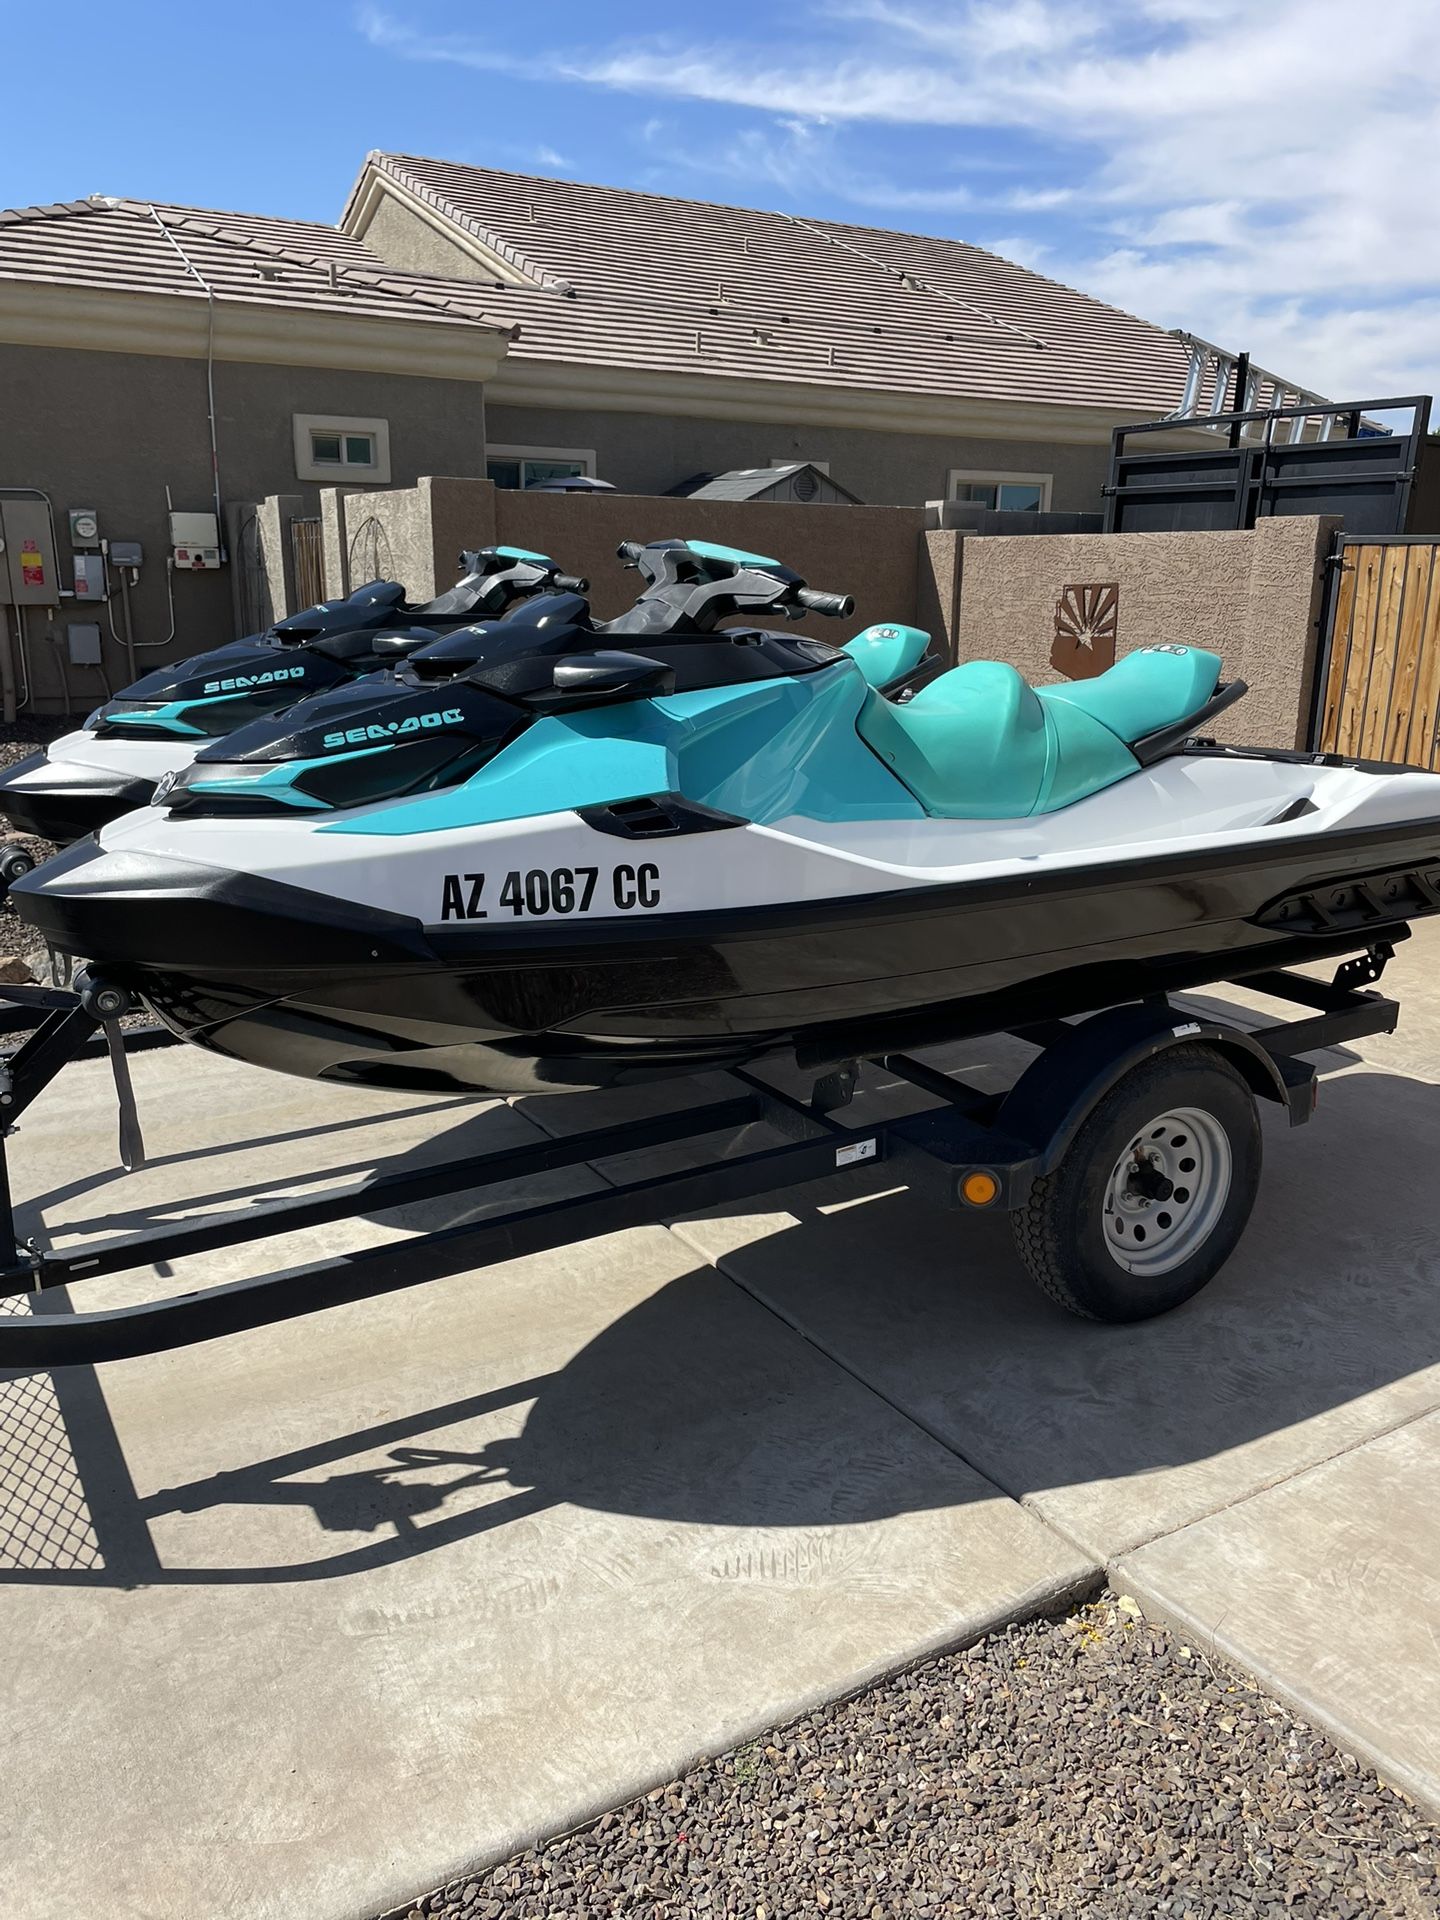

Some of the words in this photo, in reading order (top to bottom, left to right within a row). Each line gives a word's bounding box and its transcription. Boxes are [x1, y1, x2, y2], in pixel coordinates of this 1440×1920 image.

[441, 873, 488, 921] AZ
[499, 866, 599, 916] 4067
[612, 862, 661, 910] CC
